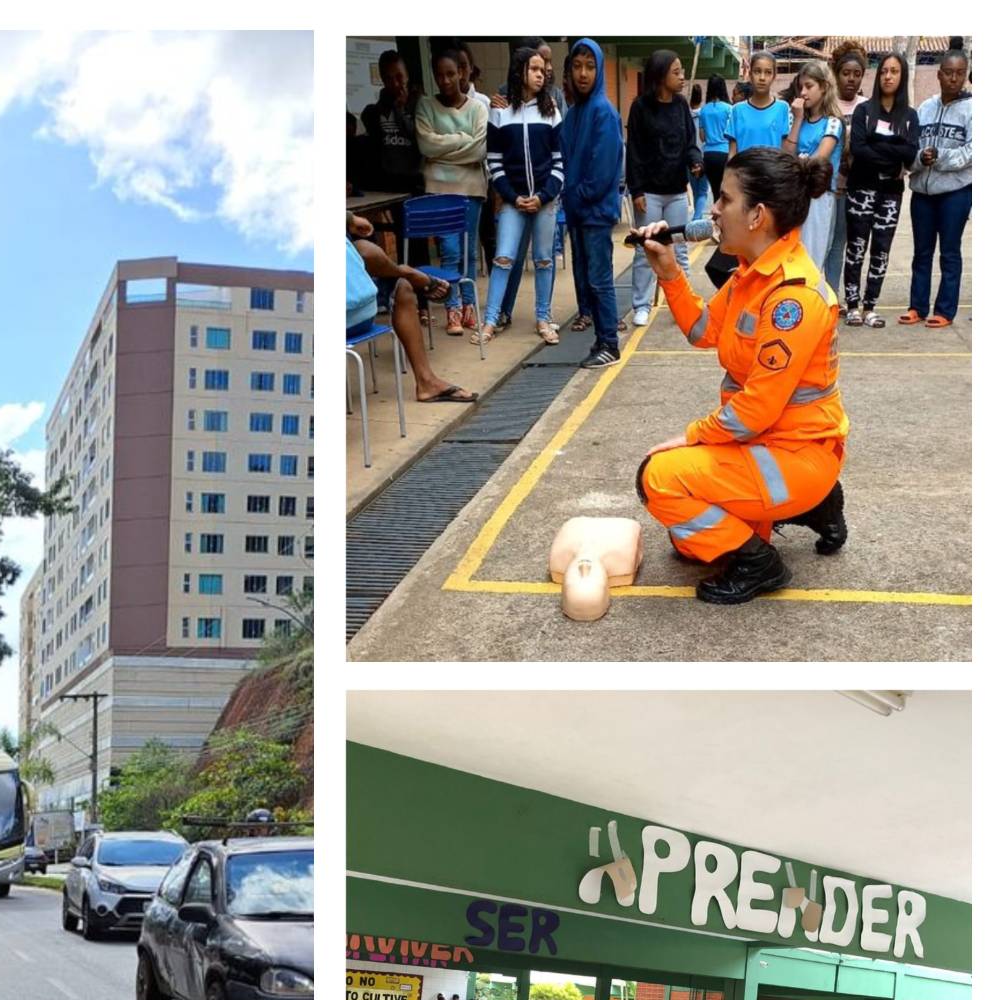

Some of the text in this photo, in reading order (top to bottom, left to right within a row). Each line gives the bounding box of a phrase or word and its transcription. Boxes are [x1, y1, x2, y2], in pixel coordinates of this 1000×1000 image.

[579, 820, 926, 958] APRENDER
[465, 899, 560, 956] SER
[359, 976, 375, 987] NO
